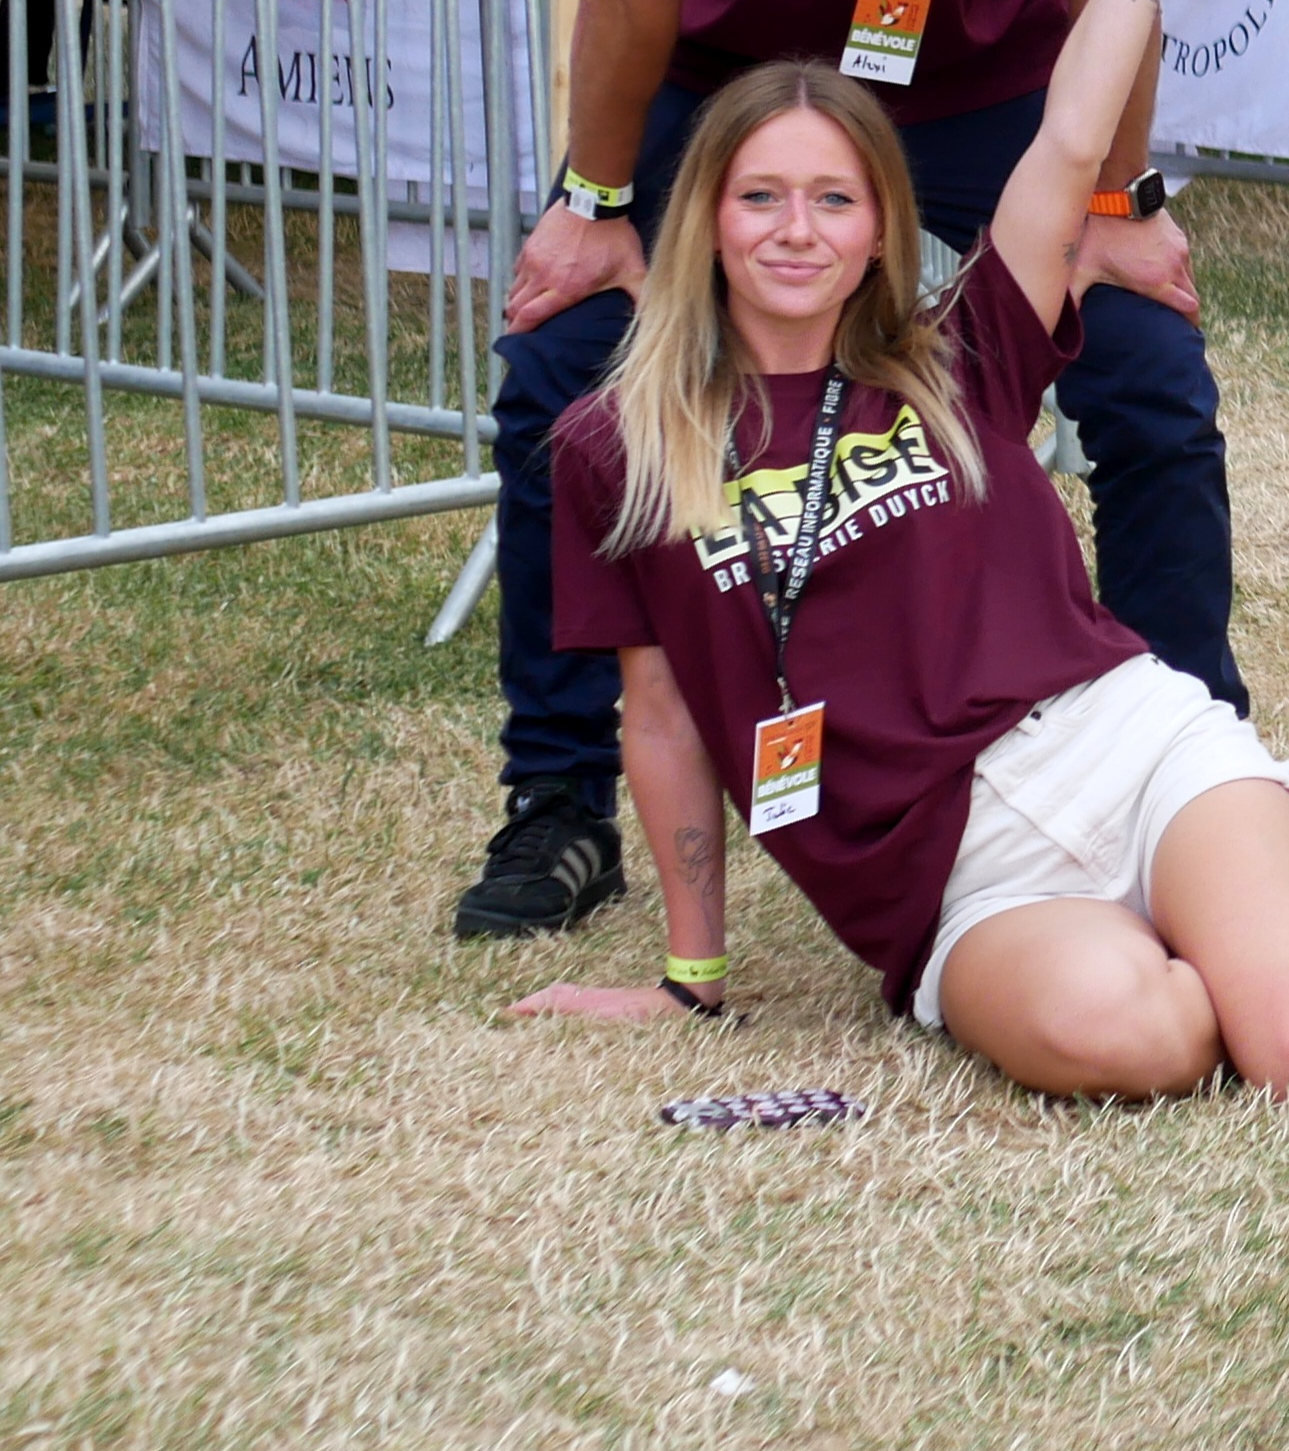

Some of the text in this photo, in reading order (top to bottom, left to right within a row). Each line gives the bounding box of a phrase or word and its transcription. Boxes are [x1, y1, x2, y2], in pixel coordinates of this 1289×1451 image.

[850, 27, 917, 53] BÉNÉVOLE
[784, 425, 834, 600] RESEAU INFORMATIQUE
[867, 479, 951, 529] DUYCK
[757, 766, 818, 799] BÉNÉVOLE
